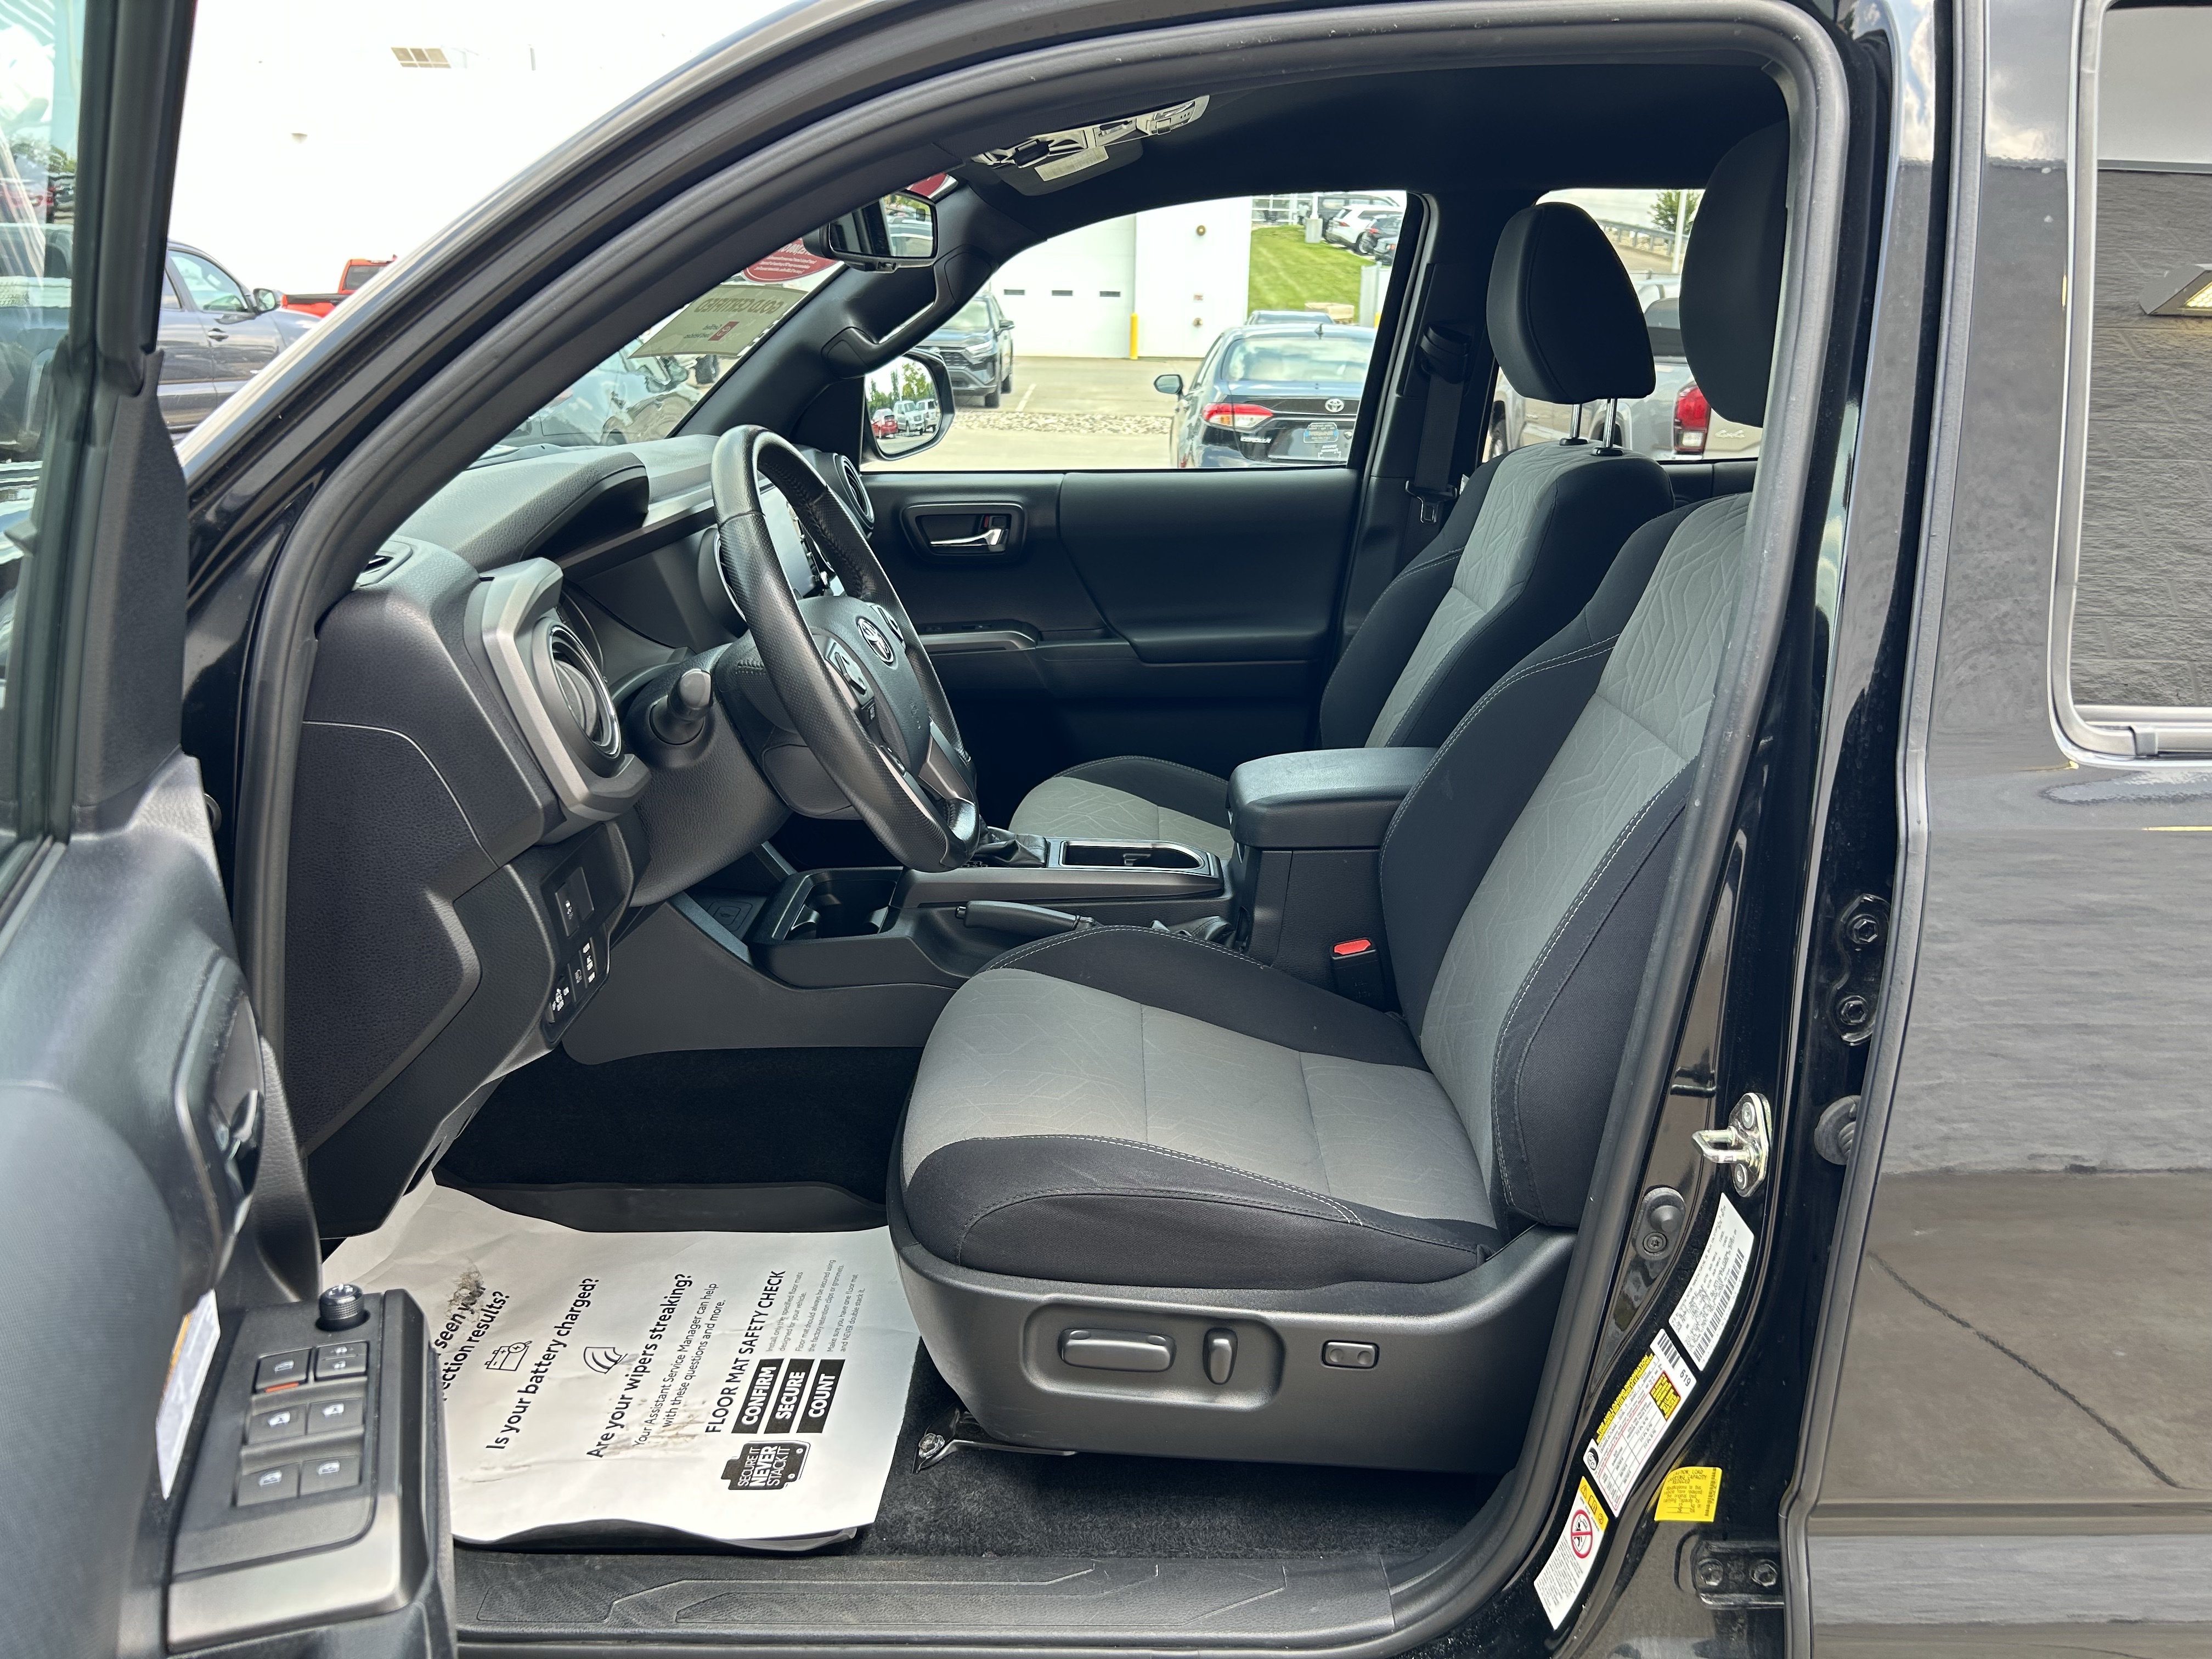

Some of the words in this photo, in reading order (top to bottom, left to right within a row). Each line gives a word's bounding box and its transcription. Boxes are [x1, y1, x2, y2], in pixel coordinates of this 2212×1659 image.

[701, 1283, 719, 1300] help
[795, 1339, 805, 1352] Floor
[806, 1312, 816, 1328] should
[812, 1295, 822, 1311] always
[820, 1272, 830, 1289] secured
[826, 1260, 836, 1272] using
[697, 1301, 709, 1315] can
[710, 1300, 726, 1322] more.
[766, 1336, 777, 1352] Install
[774, 1325, 783, 1336] only
[782, 1295, 794, 1316] specified
[817, 1304, 830, 1327] retention
[843, 1325, 854, 1341] NEVER
[850, 1307, 860, 1324] double
[855, 1293, 864, 1307] stack
[435, 1313, 466, 1349] seen
[443, 1345, 476, 1390] ection
[466, 1291, 510, 1342] results?
[678, 1316, 702, 1352] Manager
[703, 1323, 715, 1340] and
[780, 1329, 792, 1351] designed
[808, 1341, 816, 1352] the
[811, 1325, 823, 1342] factory
[827, 1338, 837, 1352] Make
[486, 1437, 510, 1449] Is
[500, 1397, 532, 1434] your
[517, 1339, 567, 1394] battery
[554, 1278, 599, 1336] charged?
[586, 1432, 615, 1458] Are
[606, 1394, 633, 1429] your
[624, 1343, 658, 1391] wipers
[650, 1273, 693, 1340] streaking?
[664, 1353, 686, 1383] Service
[685, 1341, 708, 1381] questions
[705, 1386, 739, 1433] FLOOR
[725, 1357, 750, 1383] MAT
[738, 1310, 769, 1354] SAFETY
[758, 1271, 786, 1308] CHECK
[1596, 1421, 1604, 1435] TIRE
[1602, 1410, 1611, 1424] AND
[1610, 1387, 1626, 1413] LOADING
[1624, 1353, 1648, 1391] INFORMATION
[1680, 1369, 1691, 1387] 619
[649, 1383, 672, 1425] Assistant
[670, 1382, 690, 1407] these
[741, 1367, 777, 1425] CONFIRM
[775, 1372, 806, 1420] SECURE
[808, 1373, 836, 1418] COUNT
[663, 1408, 678, 1427] with
[633, 1426, 652, 1447] Your
[777, 1446, 791, 1454] IT
[737, 1455, 758, 1487] SECURE
[749, 1446, 778, 1487] NEVER
[767, 1455, 788, 1486] STACK
